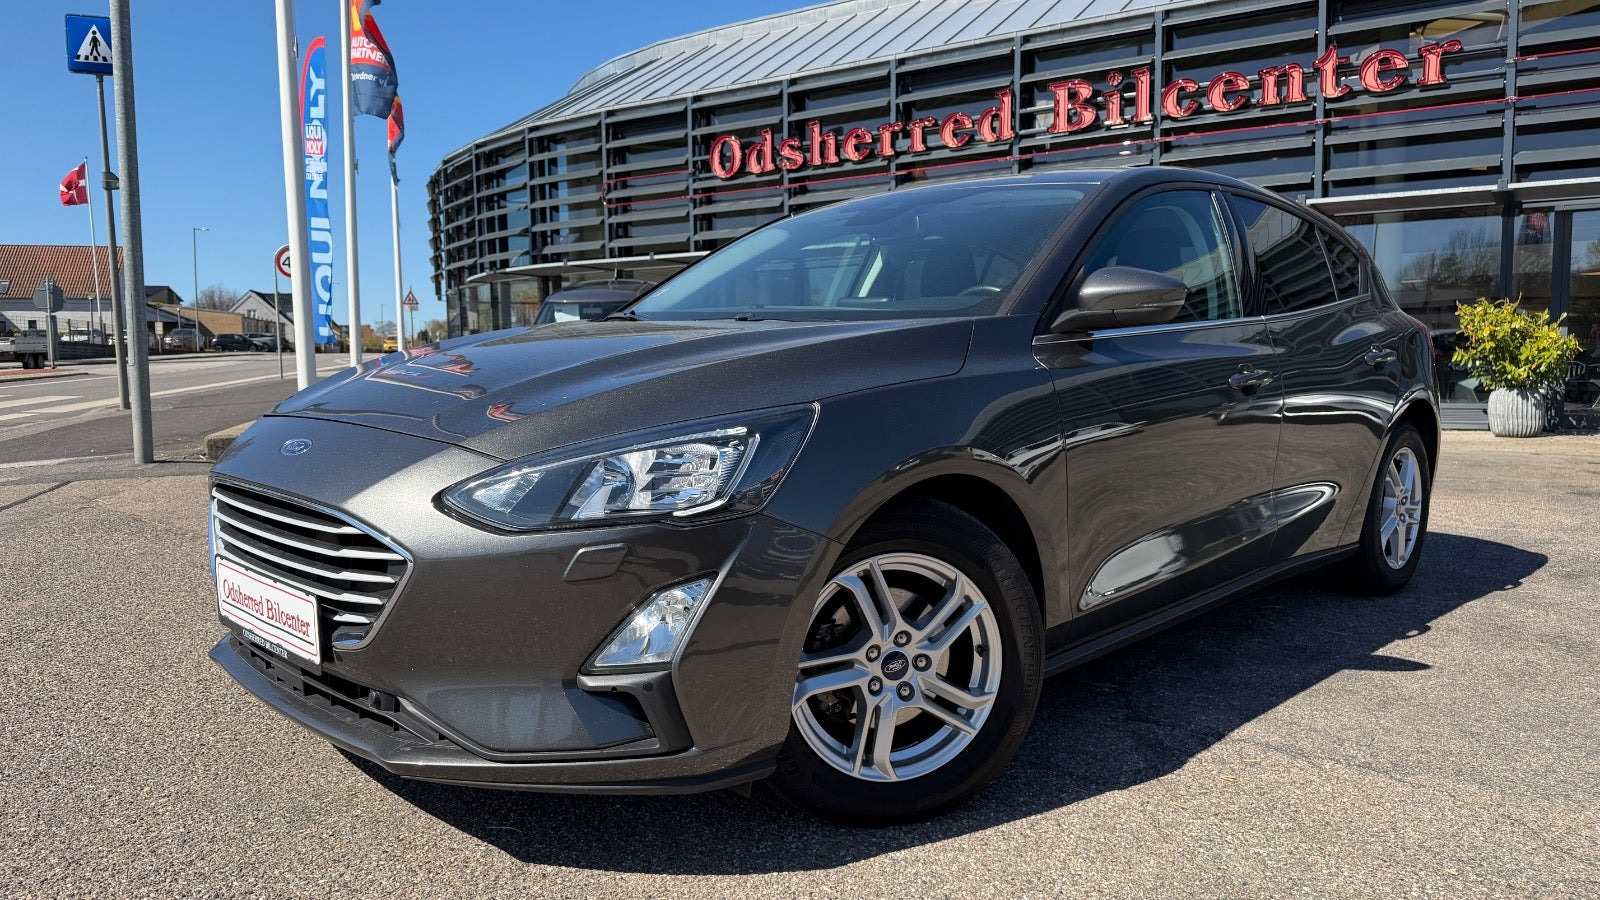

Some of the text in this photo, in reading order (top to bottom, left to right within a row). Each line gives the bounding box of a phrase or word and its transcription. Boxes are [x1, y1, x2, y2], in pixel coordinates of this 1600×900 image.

[709, 39, 1462, 179] Odsherred Bilcenter
[222, 578, 312, 638] Odsherred Bilcenter
